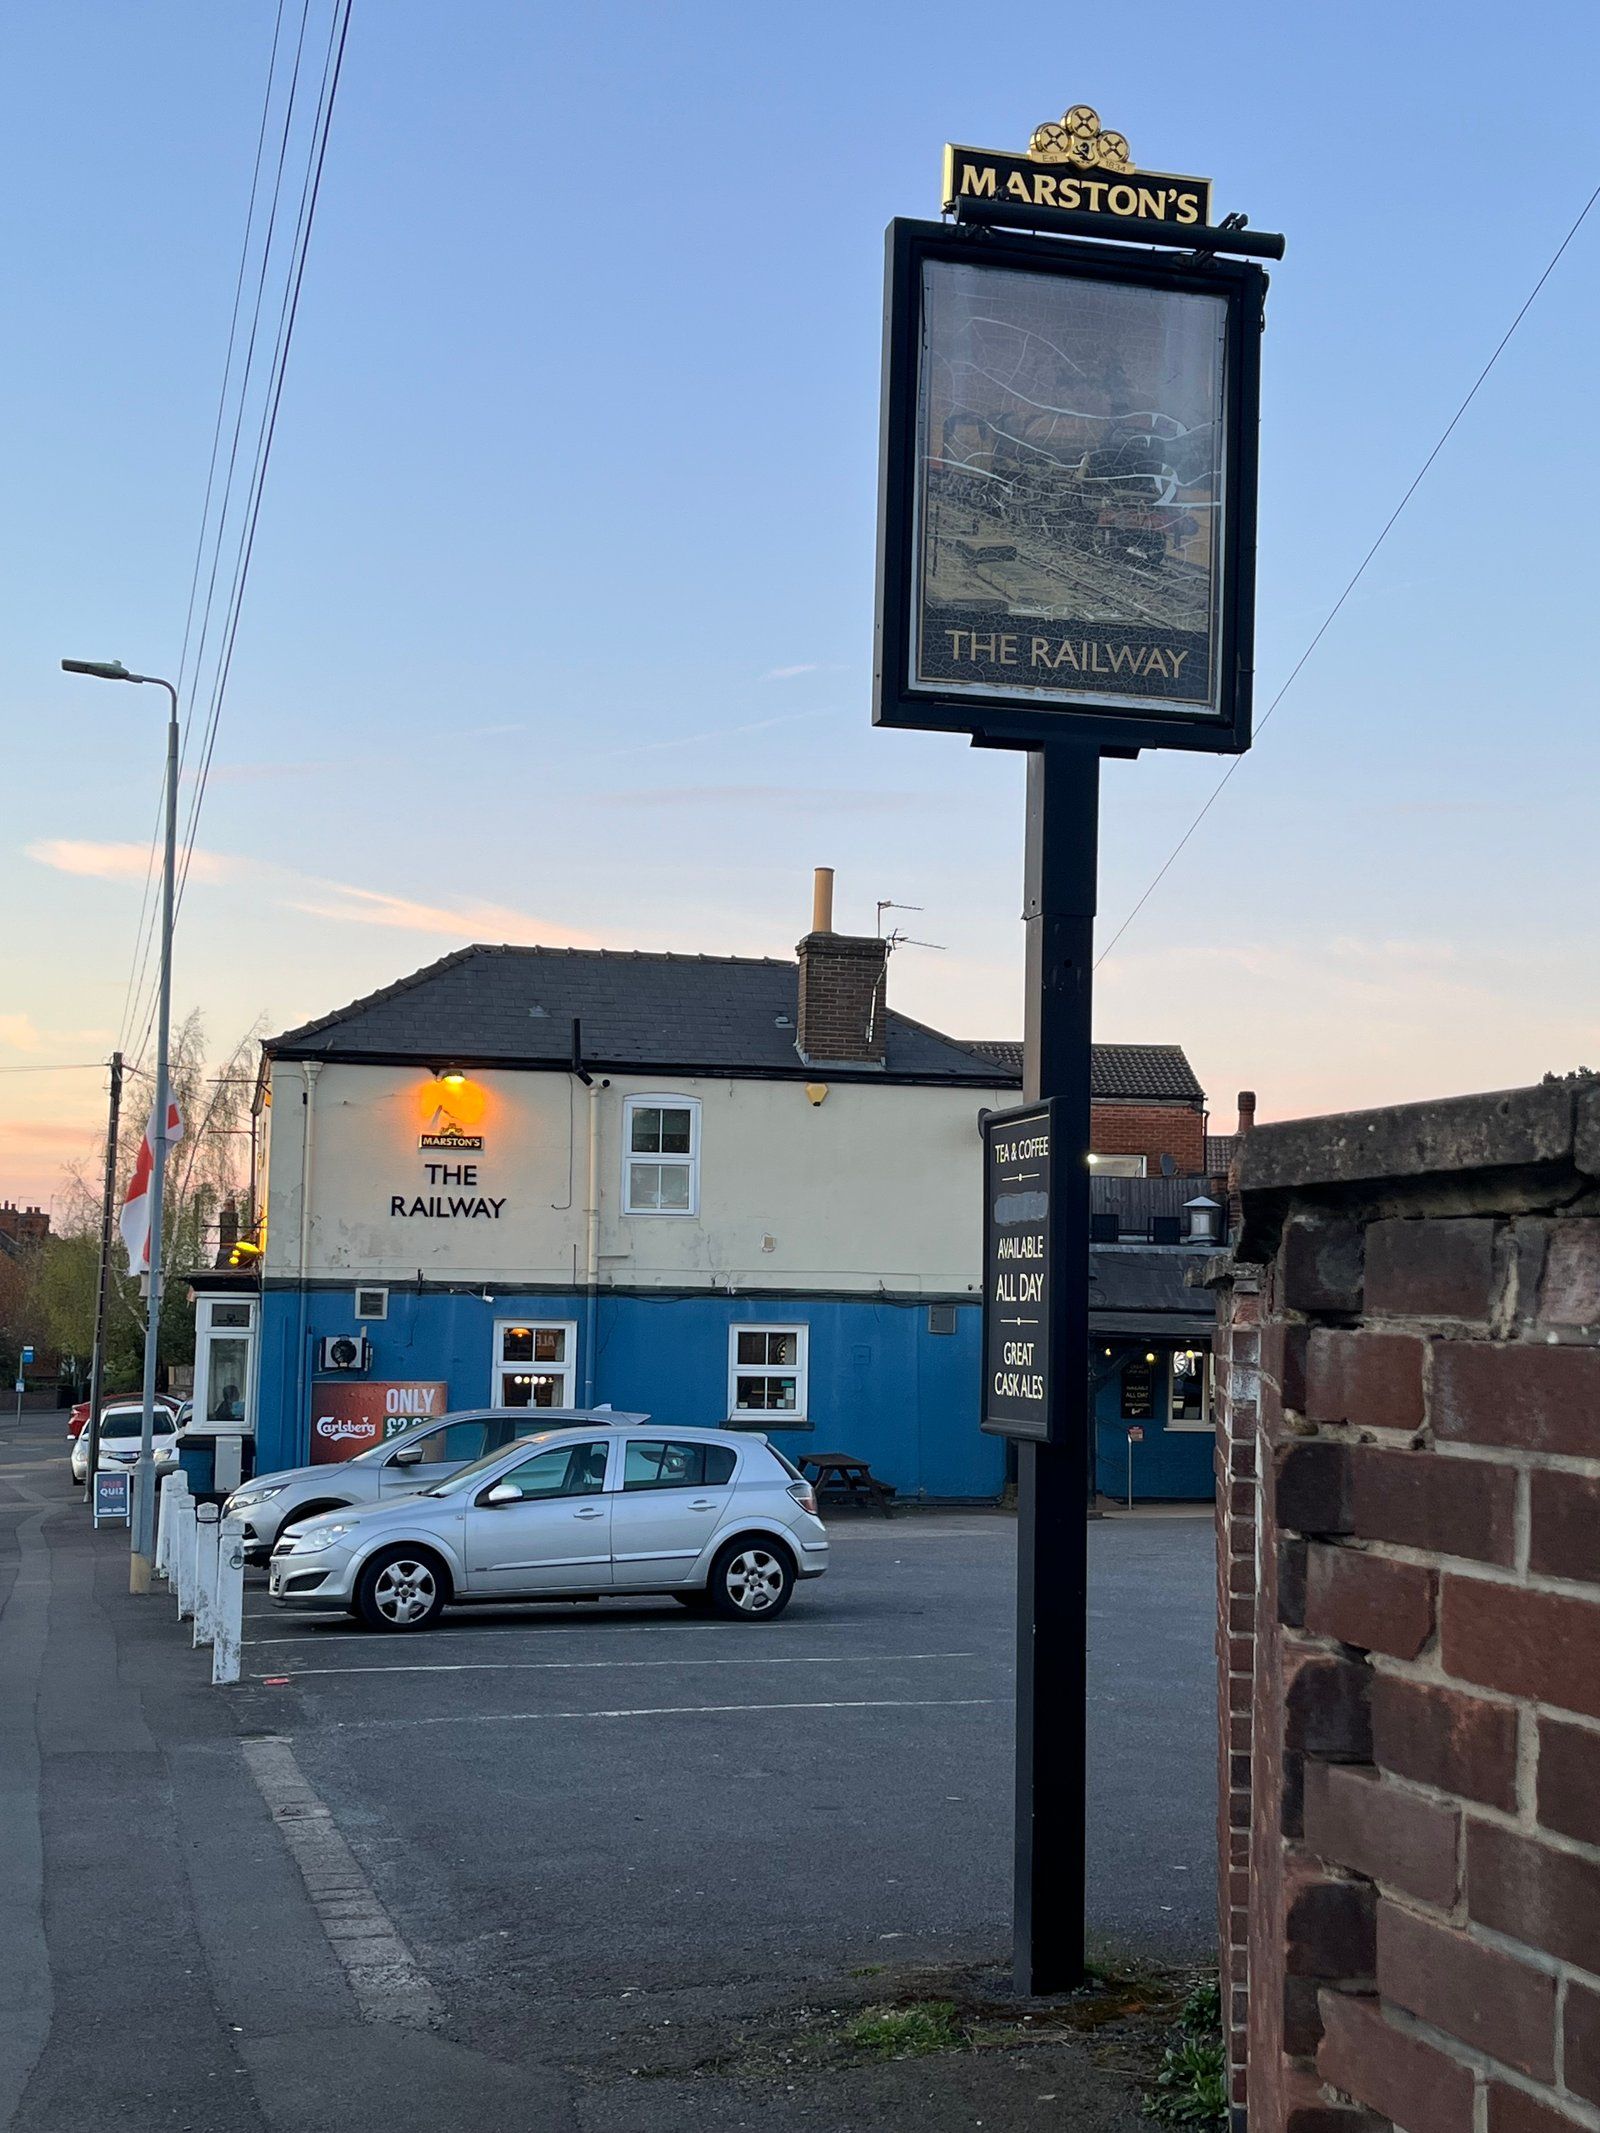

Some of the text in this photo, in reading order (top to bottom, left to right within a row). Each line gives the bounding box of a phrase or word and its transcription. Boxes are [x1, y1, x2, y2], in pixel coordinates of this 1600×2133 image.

[1105, 161, 1126, 173] 1834
[960, 164, 1199, 224] MARSTON'S
[944, 629, 1189, 678] THE RAILWAY
[422, 1137, 480, 1147] MARSTON'S
[995, 1136, 1049, 1163] TEA & COFFEE
[424, 1164, 478, 1186] THE
[391, 1195, 507, 1218] RAILWAY
[998, 1235, 1044, 1260] AVAILABLE
[996, 1273, 1044, 1302] ALL DAY
[1003, 1341, 1034, 1366] GREAT
[994, 1372, 1044, 1400] CASK ALES
[386, 1388, 436, 1413] ONLY
[316, 1416, 376, 1437] Carlsberg
[100, 1488, 124, 1497] QUIZ
